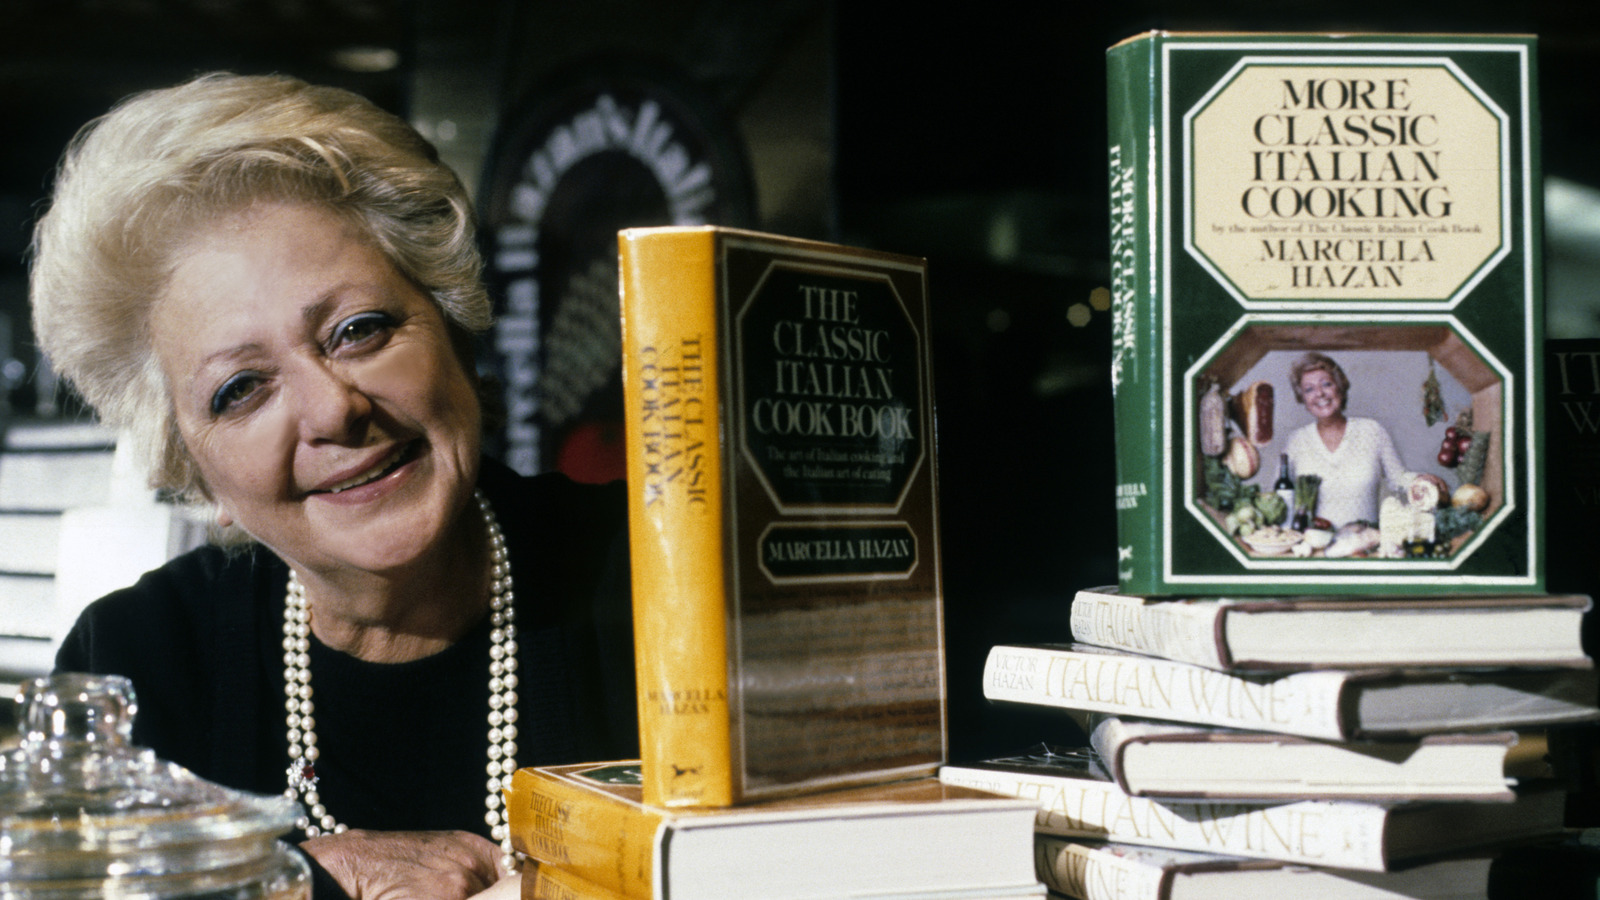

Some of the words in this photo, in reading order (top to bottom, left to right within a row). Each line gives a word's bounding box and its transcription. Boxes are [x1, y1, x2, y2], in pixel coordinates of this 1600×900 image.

[1281, 77, 1411, 111] MORE
[1253, 113, 1440, 147] CLASSIC
[1251, 150, 1442, 182] ITALIAN
[1110, 145, 1122, 256] ITALIAN
[1122, 167, 1135, 243] MORE
[1241, 186, 1454, 219] COOKING
[1211, 223, 1225, 234] by
[1228, 223, 1246, 233] the
[1249, 223, 1288, 233] author
[1291, 223, 1303, 233] of
[1308, 223, 1328, 233] The
[1331, 223, 1373, 233] Classic
[1378, 223, 1417, 233] Italian
[1418, 223, 1449, 233] Cook
[1452, 223, 1482, 233] Book
[1260, 238, 1436, 263] MARCELLA
[1290, 265, 1404, 288] HAZAN
[798, 284, 860, 325] THE
[1122, 249, 1136, 359] CLASSIC
[681, 335, 703, 392] THE
[773, 320, 893, 364] CLASSIC
[640, 346, 661, 422] COOK
[775, 359, 894, 401] ITALIAN
[661, 365, 684, 484] ITALIAN
[752, 398, 835, 438] COOK
[841, 403, 915, 441] BOOK
[642, 431, 664, 507] BOOK
[684, 398, 707, 512] CLASSIC
[768, 542, 855, 562] MARCELLA
[859, 538, 910, 559] HAZAN
[992, 671, 1034, 690] HAZAN
[996, 653, 1038, 673] VICTOR
[1045, 655, 1177, 709] ITALIAN
[1189, 668, 1291, 724] WINE
[1198, 798, 1326, 859] WINE
